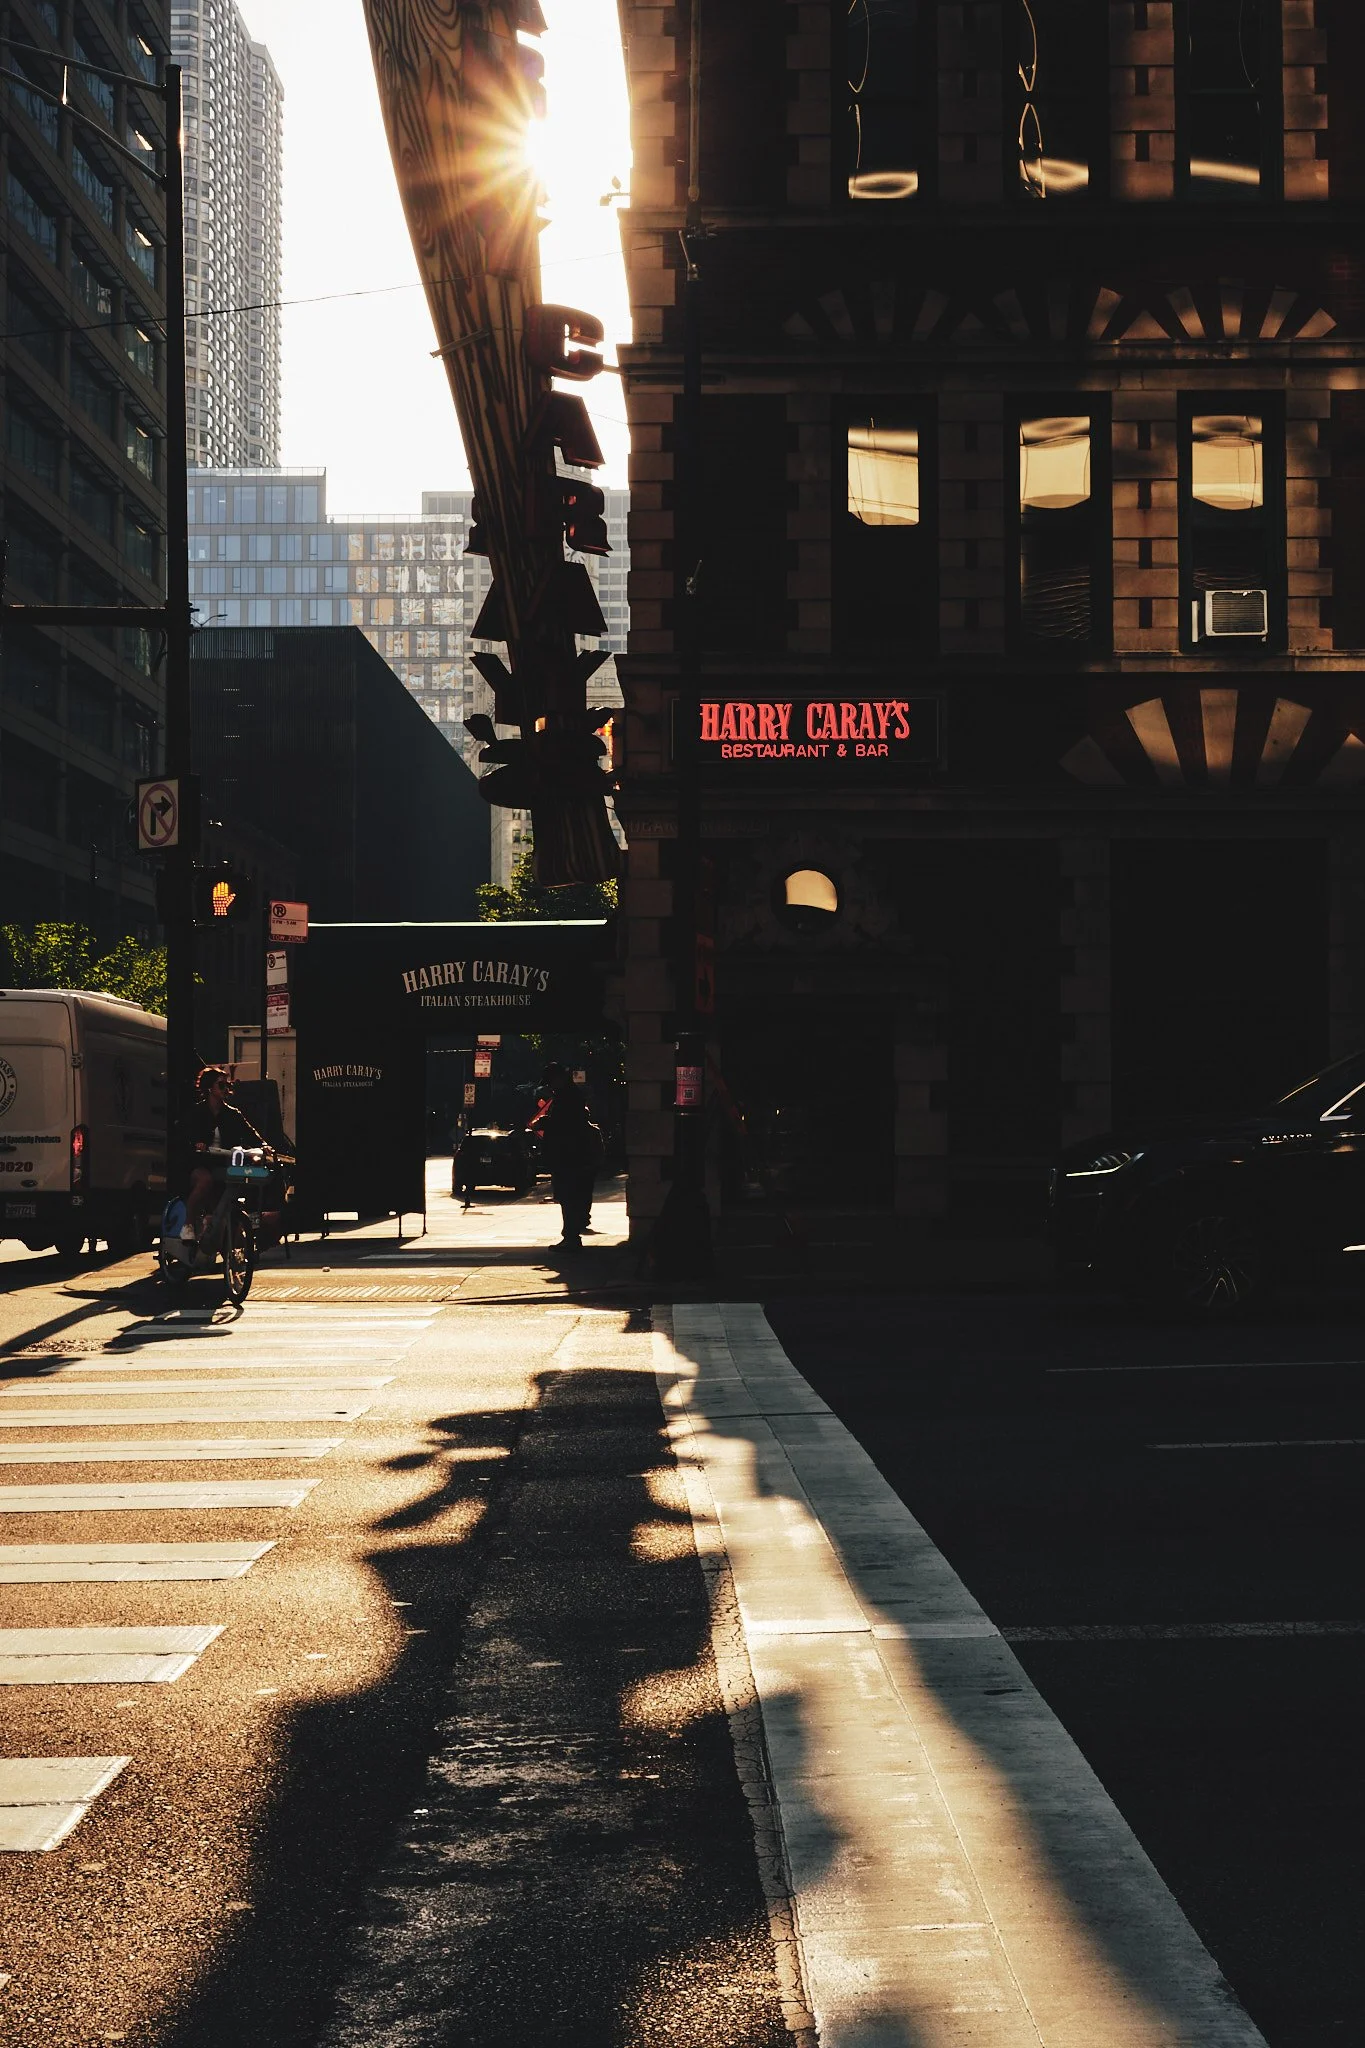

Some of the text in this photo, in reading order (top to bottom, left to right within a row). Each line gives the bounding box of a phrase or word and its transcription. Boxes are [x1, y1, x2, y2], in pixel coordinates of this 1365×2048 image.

[700, 700, 911, 741] HARRY CARAY'S
[721, 744, 890, 759] RESTAURANT & BAR
[401, 960, 550, 994] HARRY CARAY'S
[420, 994, 532, 1007] ITALIAN STEAKHOUSE
[313, 1065, 382, 1080] HARRY CARAY'S
[7, 1135, 35, 1145] Specialty
[35, 1135, 62, 1145] Products
